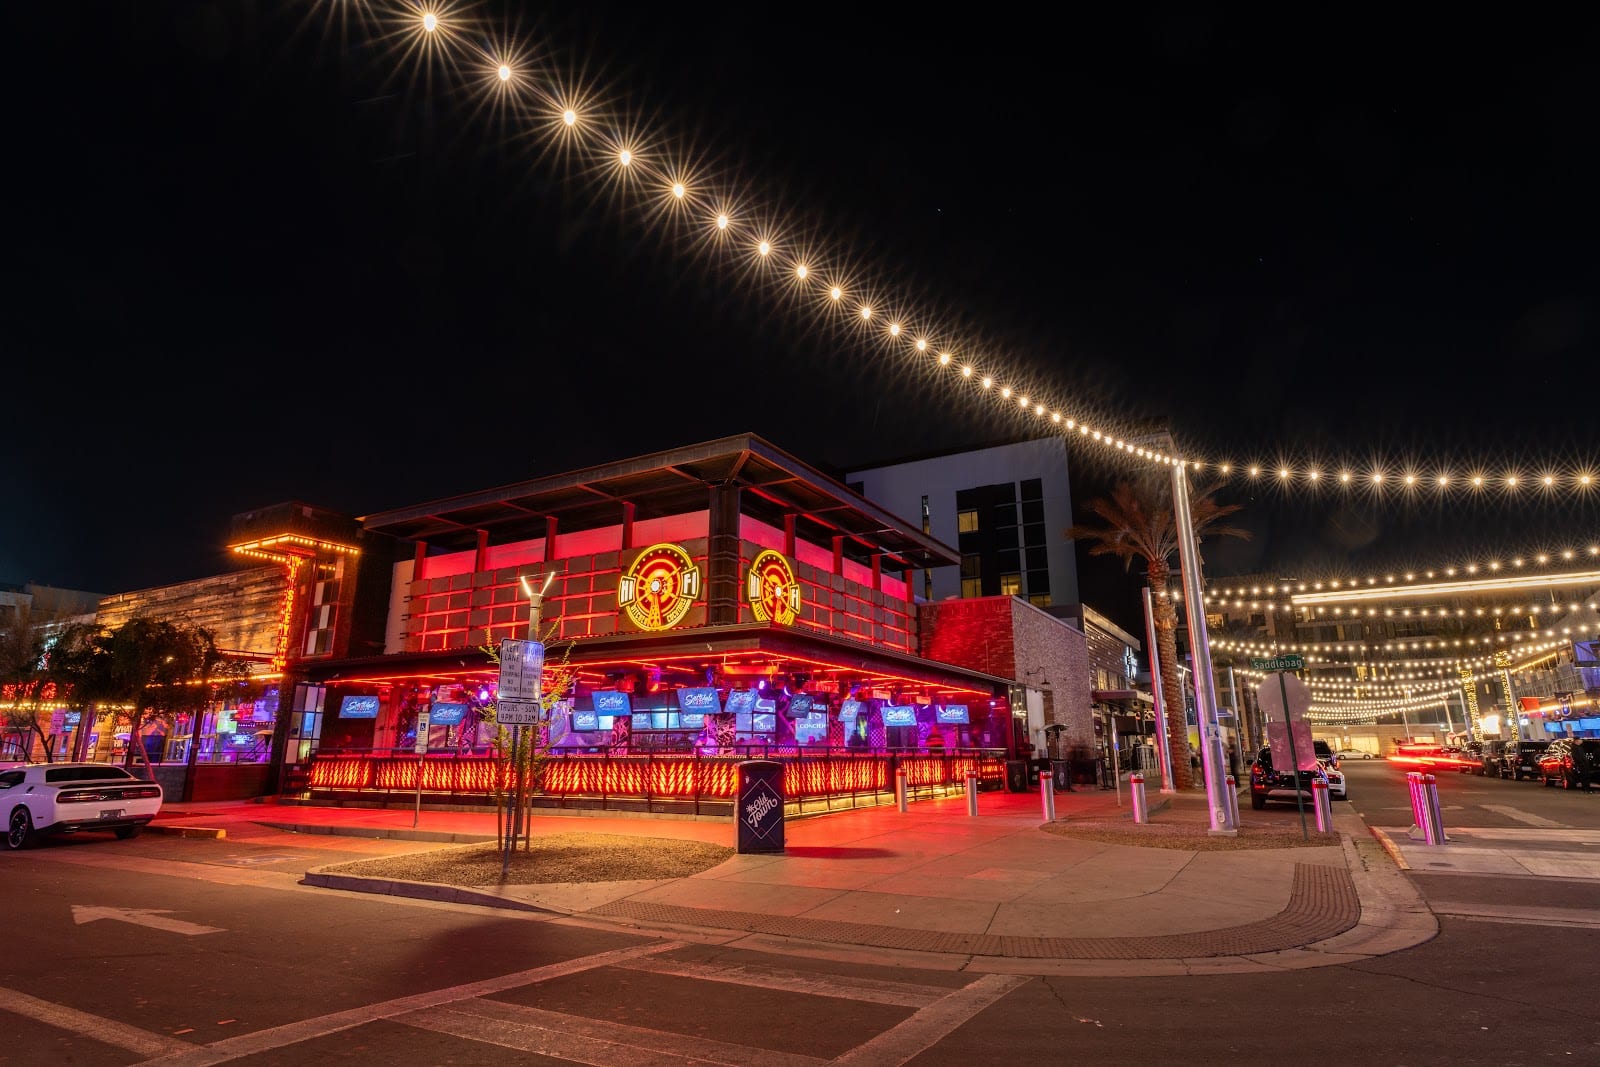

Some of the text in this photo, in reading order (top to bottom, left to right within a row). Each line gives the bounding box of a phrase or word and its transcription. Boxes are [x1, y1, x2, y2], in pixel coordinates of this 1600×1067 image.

[621, 571, 697, 603] HI FI
[750, 574, 799, 610] HI FI
[506, 644, 519, 653] LEFT
[504, 654, 520, 662] LANE
[1254, 660, 1303, 670] Saddlebag
[500, 703, 520, 713] THURS.
[753, 792, 769, 810] Old
[748, 798, 778, 828] Town
